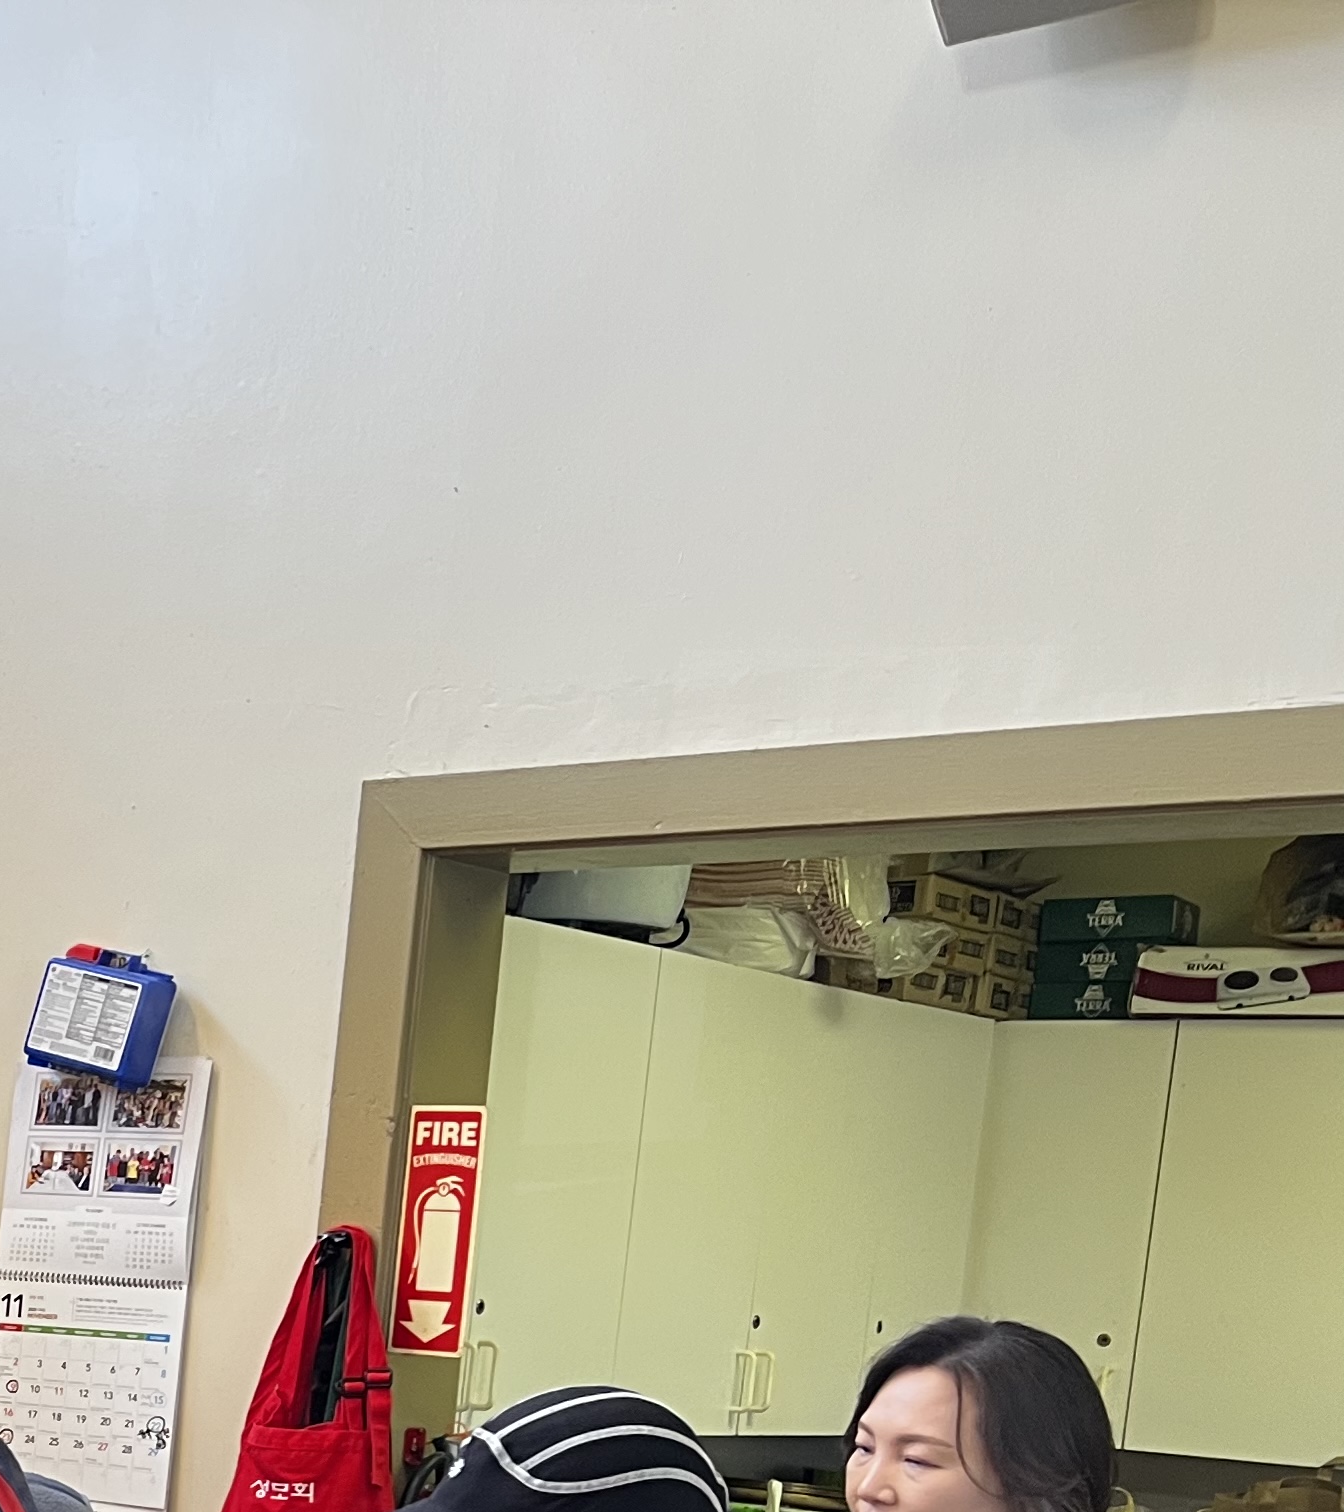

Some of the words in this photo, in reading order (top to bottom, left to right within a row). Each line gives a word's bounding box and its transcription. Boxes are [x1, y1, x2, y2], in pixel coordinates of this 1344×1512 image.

[1087, 911, 1125, 928] TERRA
[1186, 962, 1226, 972] RIVAL
[415, 1121, 479, 1147] FIRE
[1, 1293, 24, 1318] 11
[13, 1357, 19, 1366] 2
[37, 1359, 43, 1368] 3
[61, 1361, 67, 1370] 4
[85, 1363, 91, 1372] 5
[110, 1365, 116, 1374] 6
[135, 1367, 141, 1376] 7
[160, 1369, 167, 1378] 8
[30, 1384, 41, 1393] 10
[54, 1387, 64, 1396] 11
[79, 1389, 89, 1398] 12
[103, 1391, 114, 1400] 13
[127, 1393, 138, 1402] 14
[154, 1395, 164, 1404] 15
[3, 1407, 14, 1417] 16
[27, 1409, 38, 1419] 17
[52, 1412, 62, 1421] 18
[76, 1414, 87, 1424] 19
[100, 1417, 111, 1426] 20
[124, 1419, 135, 1428] 21
[24, 1435, 35, 1444] 24
[48, 1437, 59, 1446] 25
[73, 1440, 84, 1449] 26
[97, 1442, 109, 1451] 27
[122, 1445, 133, 1454] 28
[249, 1479, 315, 1504] 성모회
